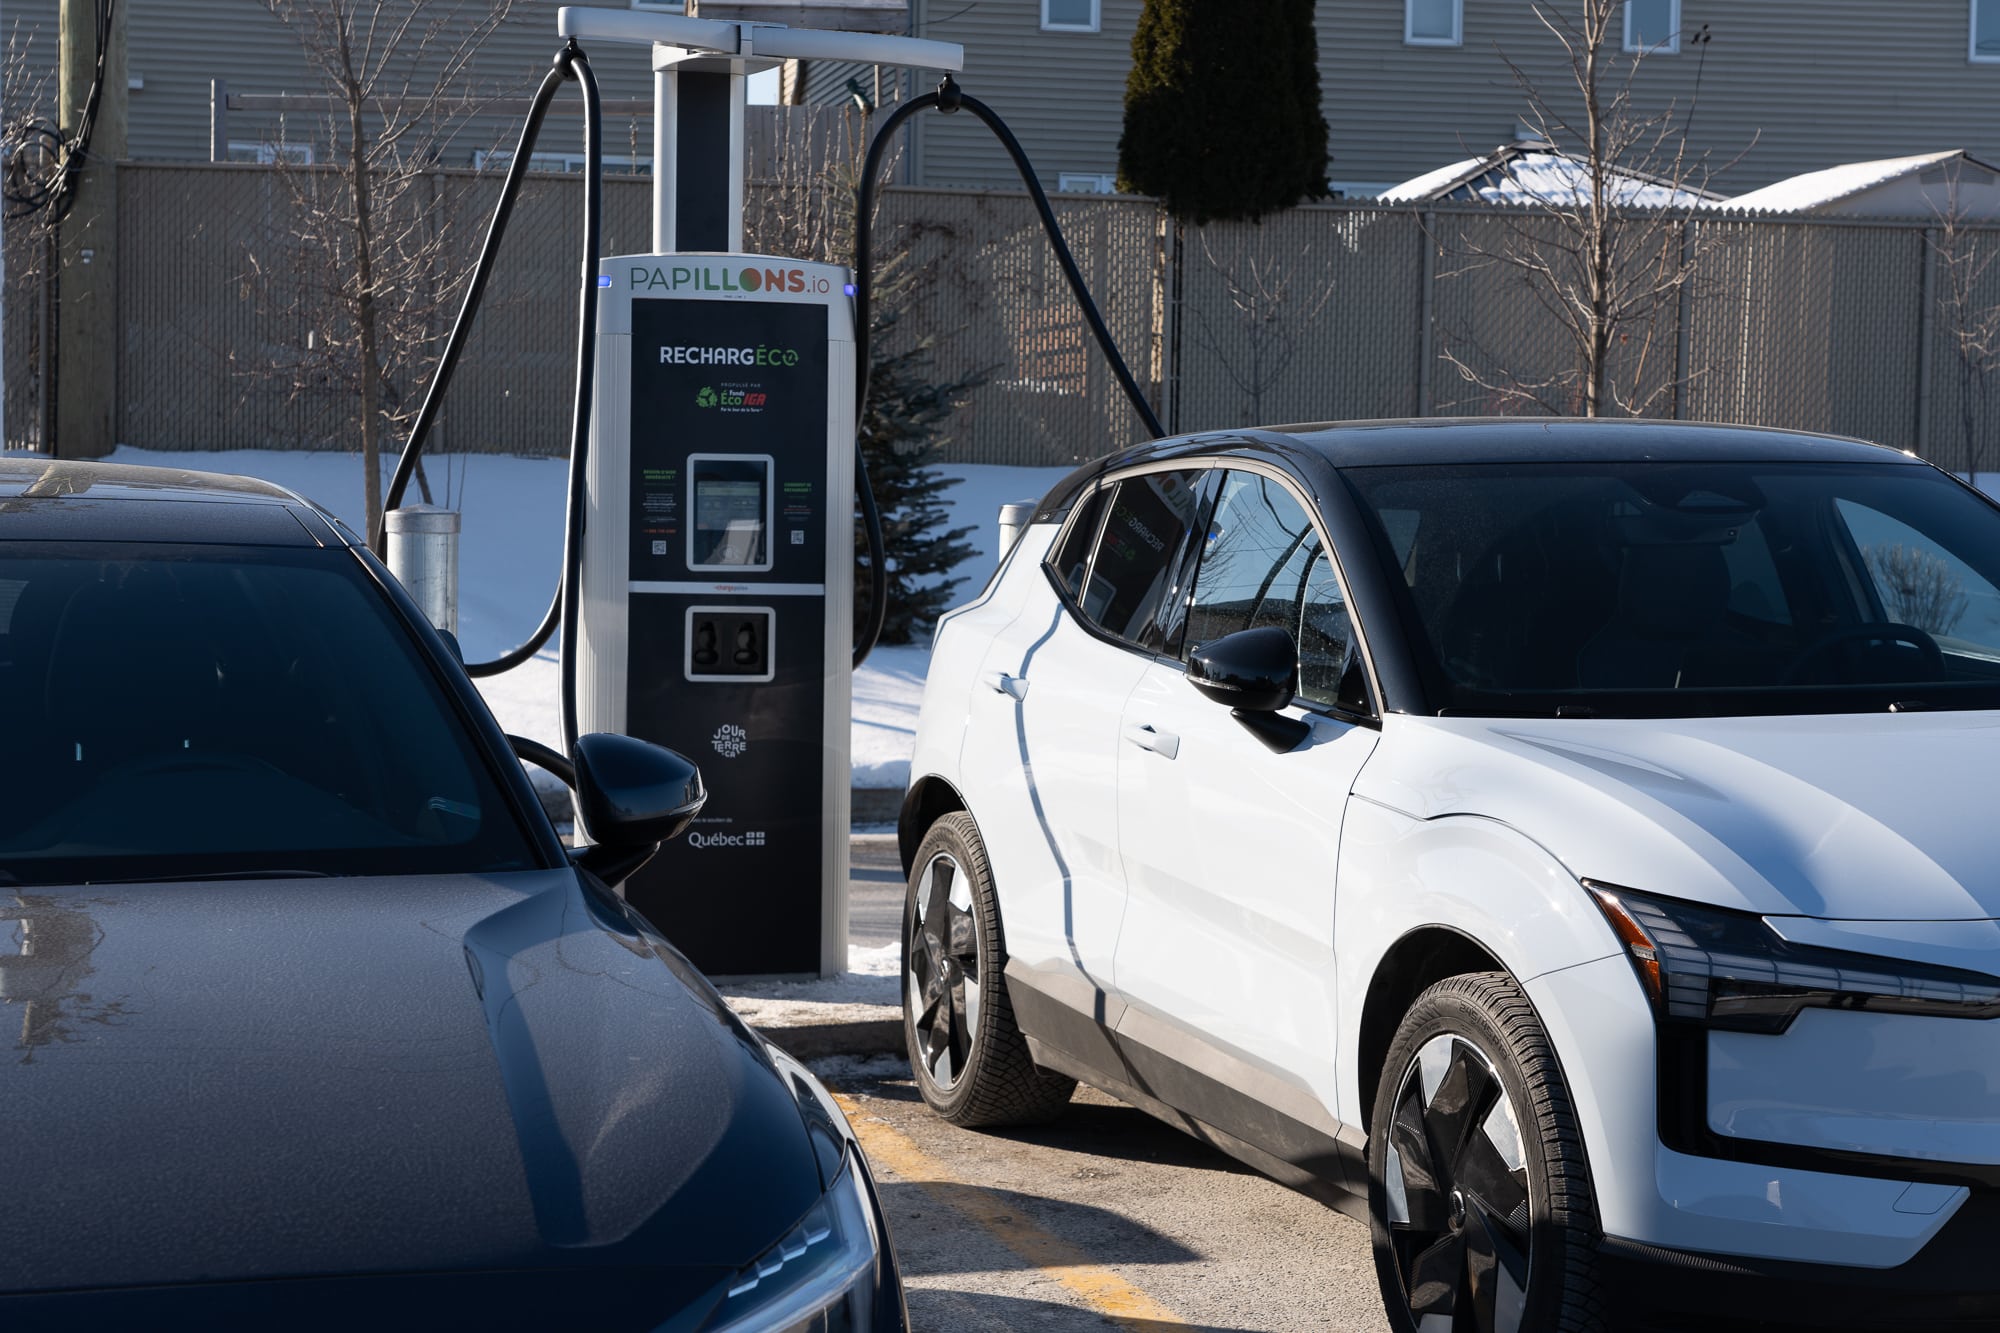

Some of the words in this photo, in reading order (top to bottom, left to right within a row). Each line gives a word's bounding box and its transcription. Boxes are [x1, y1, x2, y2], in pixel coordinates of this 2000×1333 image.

[631, 267, 830, 294] PAPILLONS.io
[720, 390, 742, 405] Éco
[743, 392, 767, 406] IGA
[713, 724, 746, 740] JOUR
[711, 740, 747, 755] TERRE
[688, 831, 744, 849] Québec
